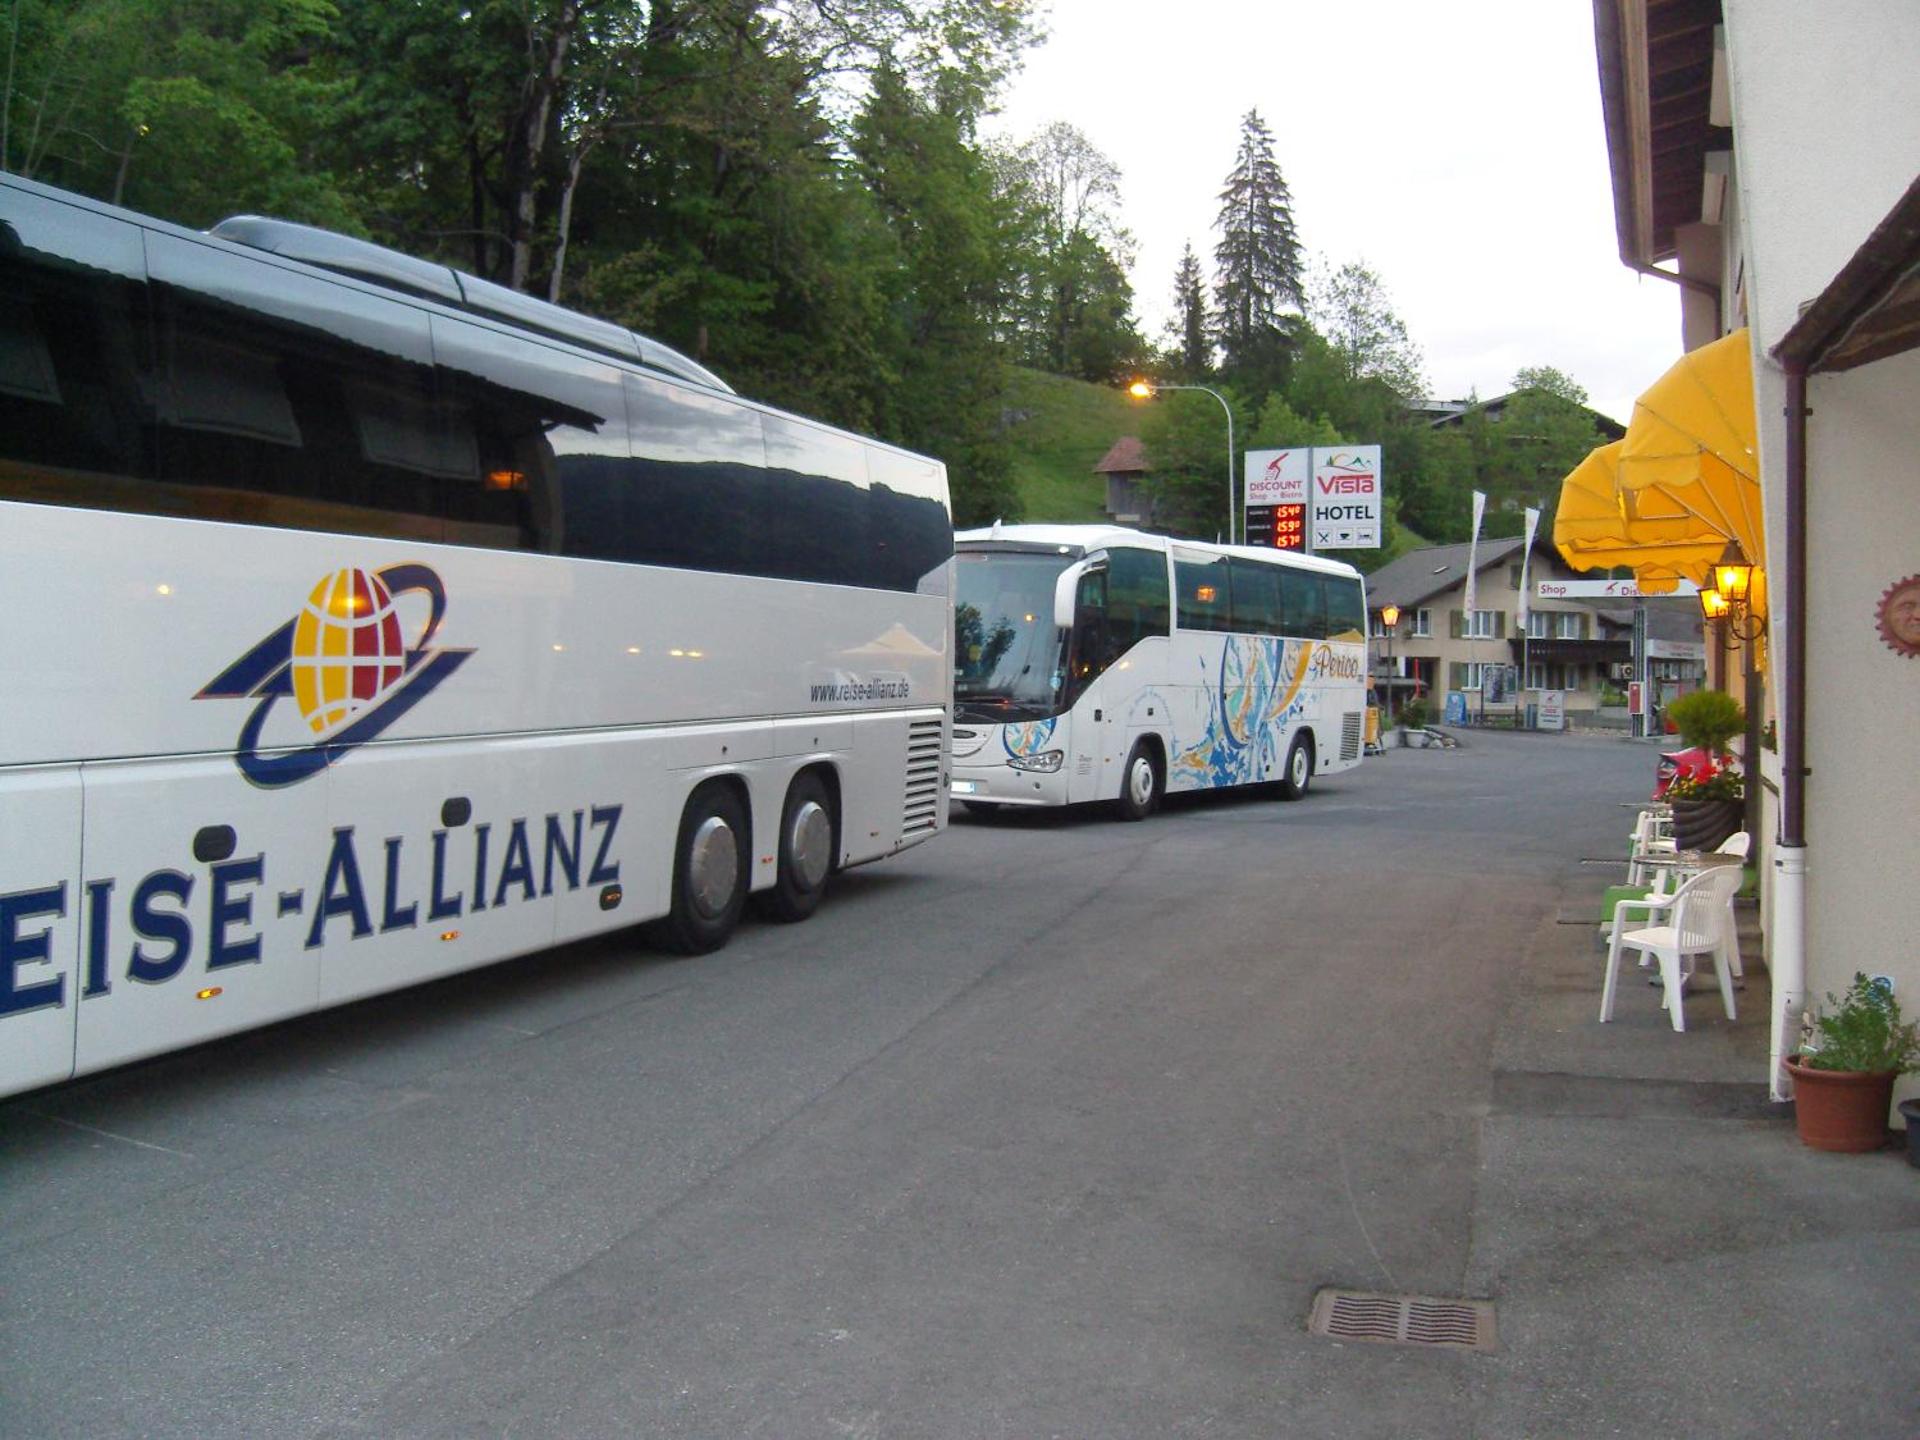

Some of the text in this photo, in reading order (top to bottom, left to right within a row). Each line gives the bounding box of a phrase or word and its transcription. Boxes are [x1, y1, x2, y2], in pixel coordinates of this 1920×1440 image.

[1249, 480, 1303, 491] DISCOUNT
[1317, 475, 1374, 494] Vista
[1316, 504, 1374, 520] HOTEL
[1540, 584, 1567, 596] Shop
[1315, 645, 1359, 678] Perico
[810, 678, 910, 703] www.reise-allianz.de
